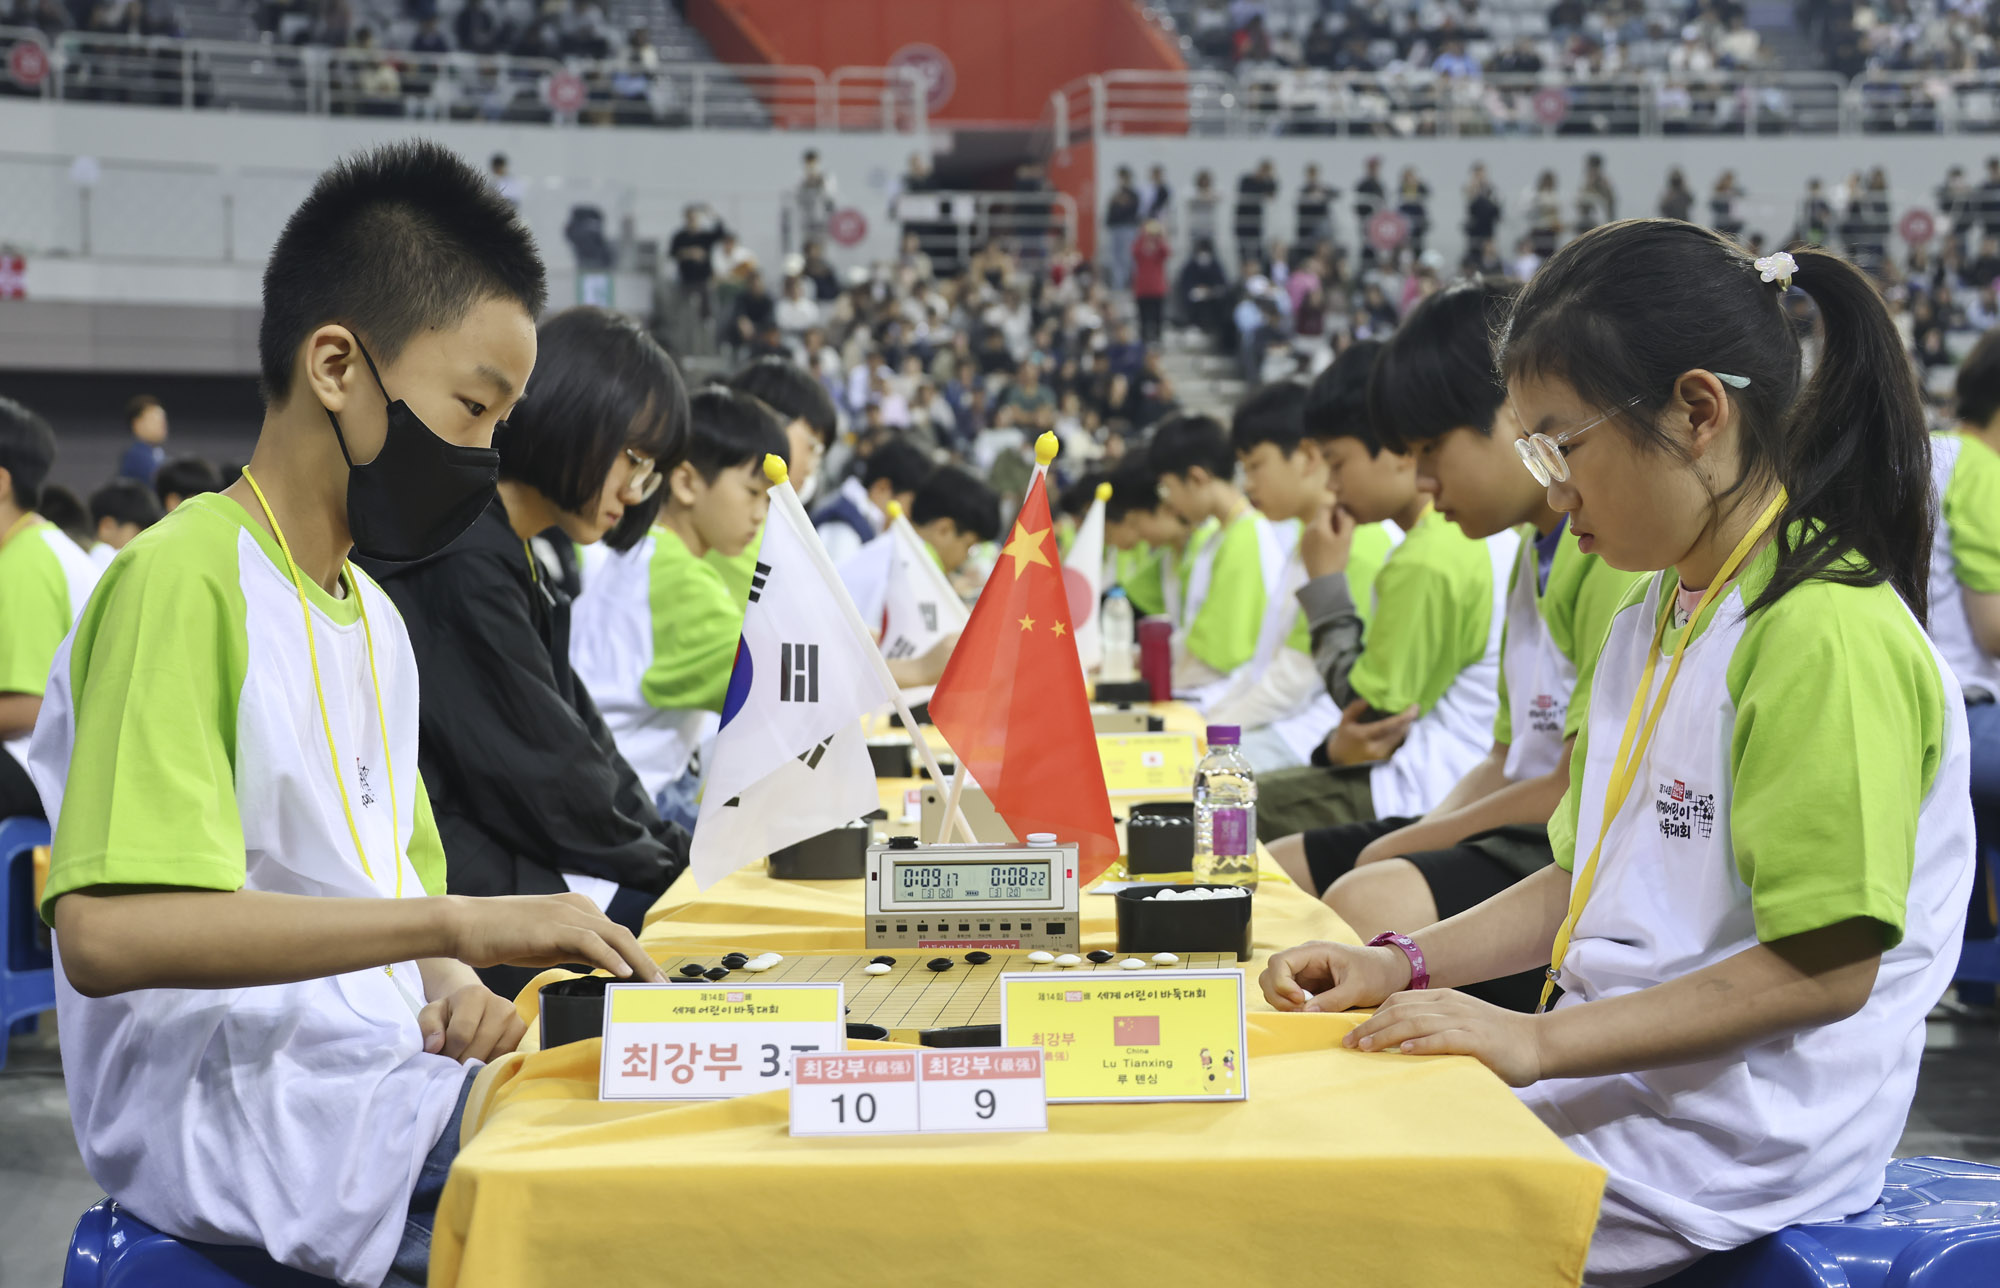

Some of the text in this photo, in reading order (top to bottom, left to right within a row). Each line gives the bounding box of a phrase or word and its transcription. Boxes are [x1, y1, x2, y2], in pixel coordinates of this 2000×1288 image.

[904, 868, 958, 888] 0:09 17
[991, 866, 1046, 886] 0:08 22
[1097, 991, 1121, 1000] 세계
[1160, 988, 1206, 1000] 바둑대회
[672, 1006, 696, 1014] 세계
[734, 1004, 779, 1015] 바둑대회
[1032, 1032, 1076, 1047] 최강부
[621, 1042, 819, 1084] 최강부 3
[1103, 1058, 1173, 1068] Lu Tianxing
[831, 1092, 877, 1123] 10
[974, 1088, 996, 1119] 9
